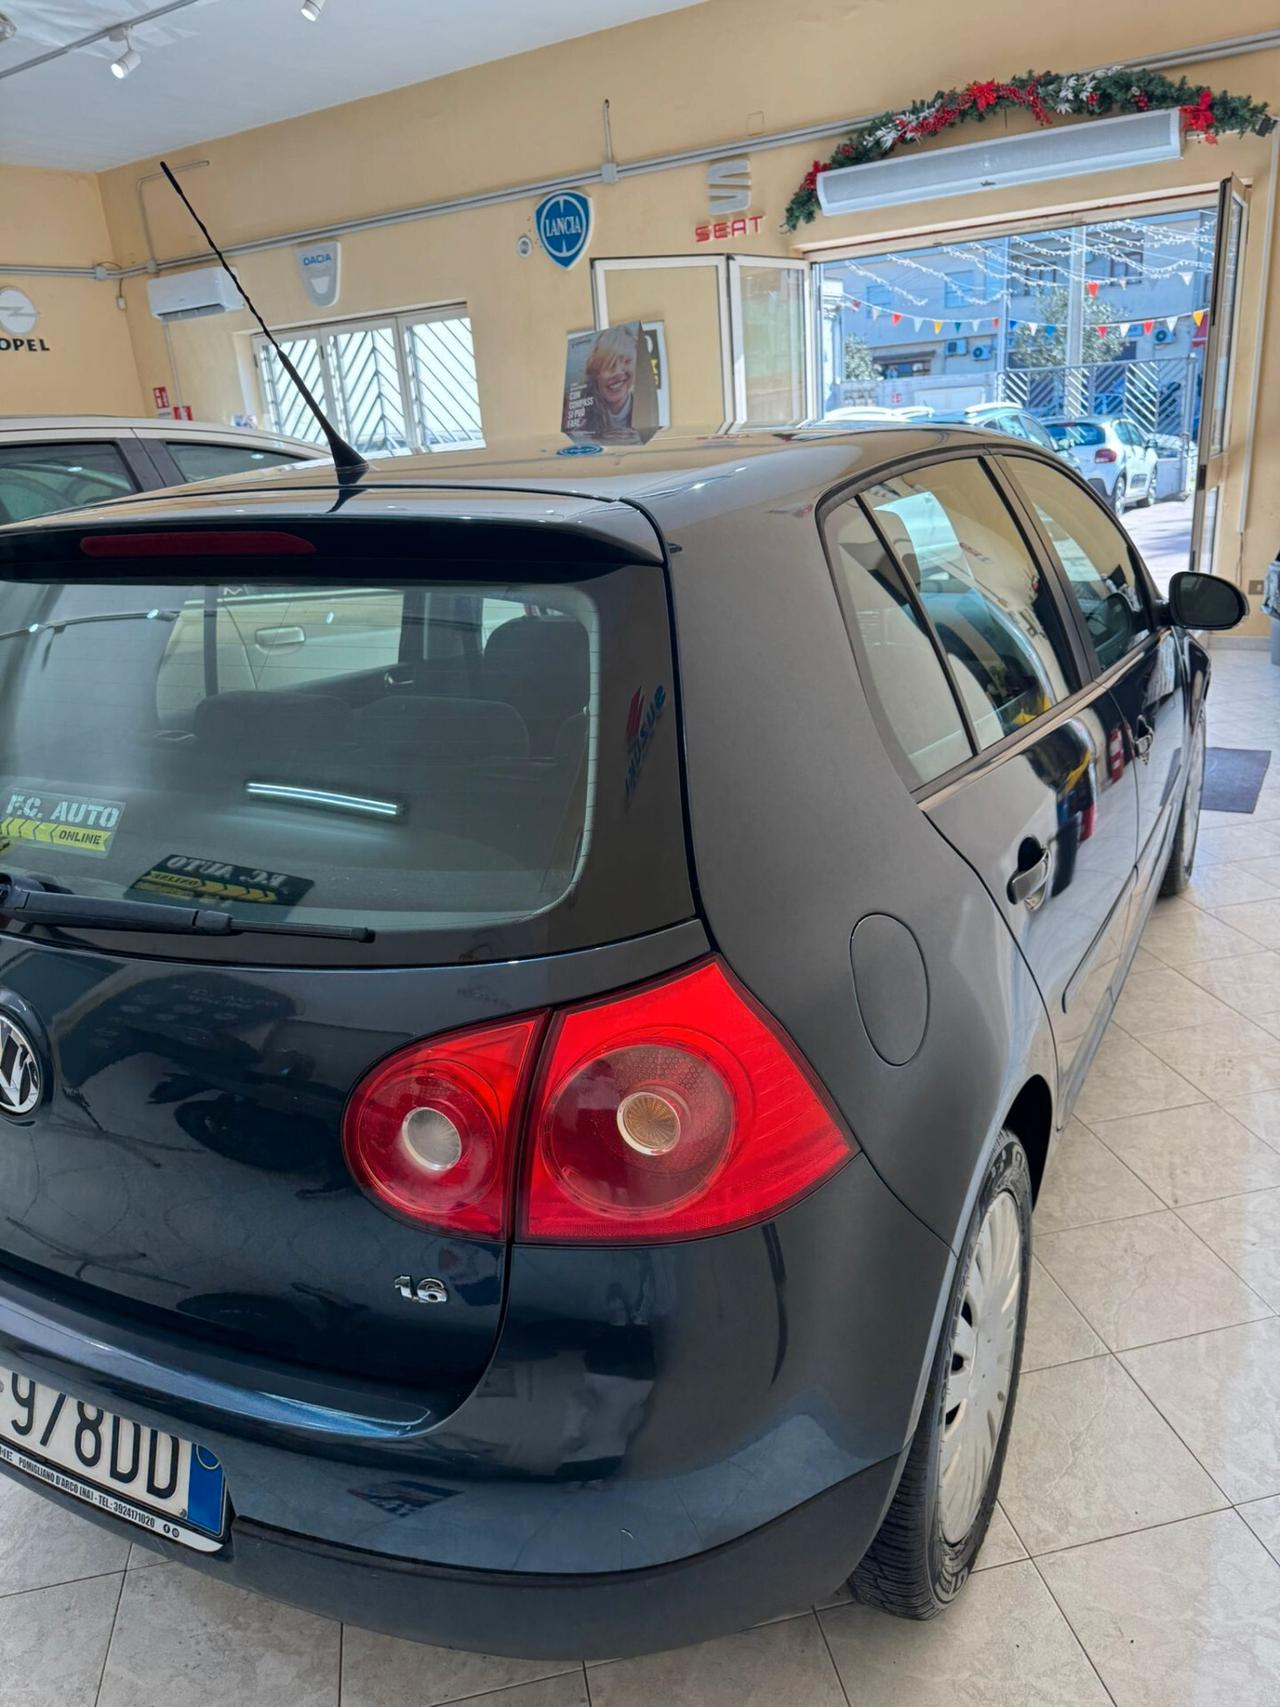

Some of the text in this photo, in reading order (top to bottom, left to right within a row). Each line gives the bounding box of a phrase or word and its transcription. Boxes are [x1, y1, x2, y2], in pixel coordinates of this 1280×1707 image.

[545, 216, 582, 237] LANCIA
[694, 215, 763, 242] SEAT
[303, 253, 331, 266] DACIA
[0, 338, 51, 351] OPEL
[50, 801, 119, 828] AUTO
[59, 830, 102, 845] ONLINE
[19, 1456, 55, 1483] POMIGLIANO
